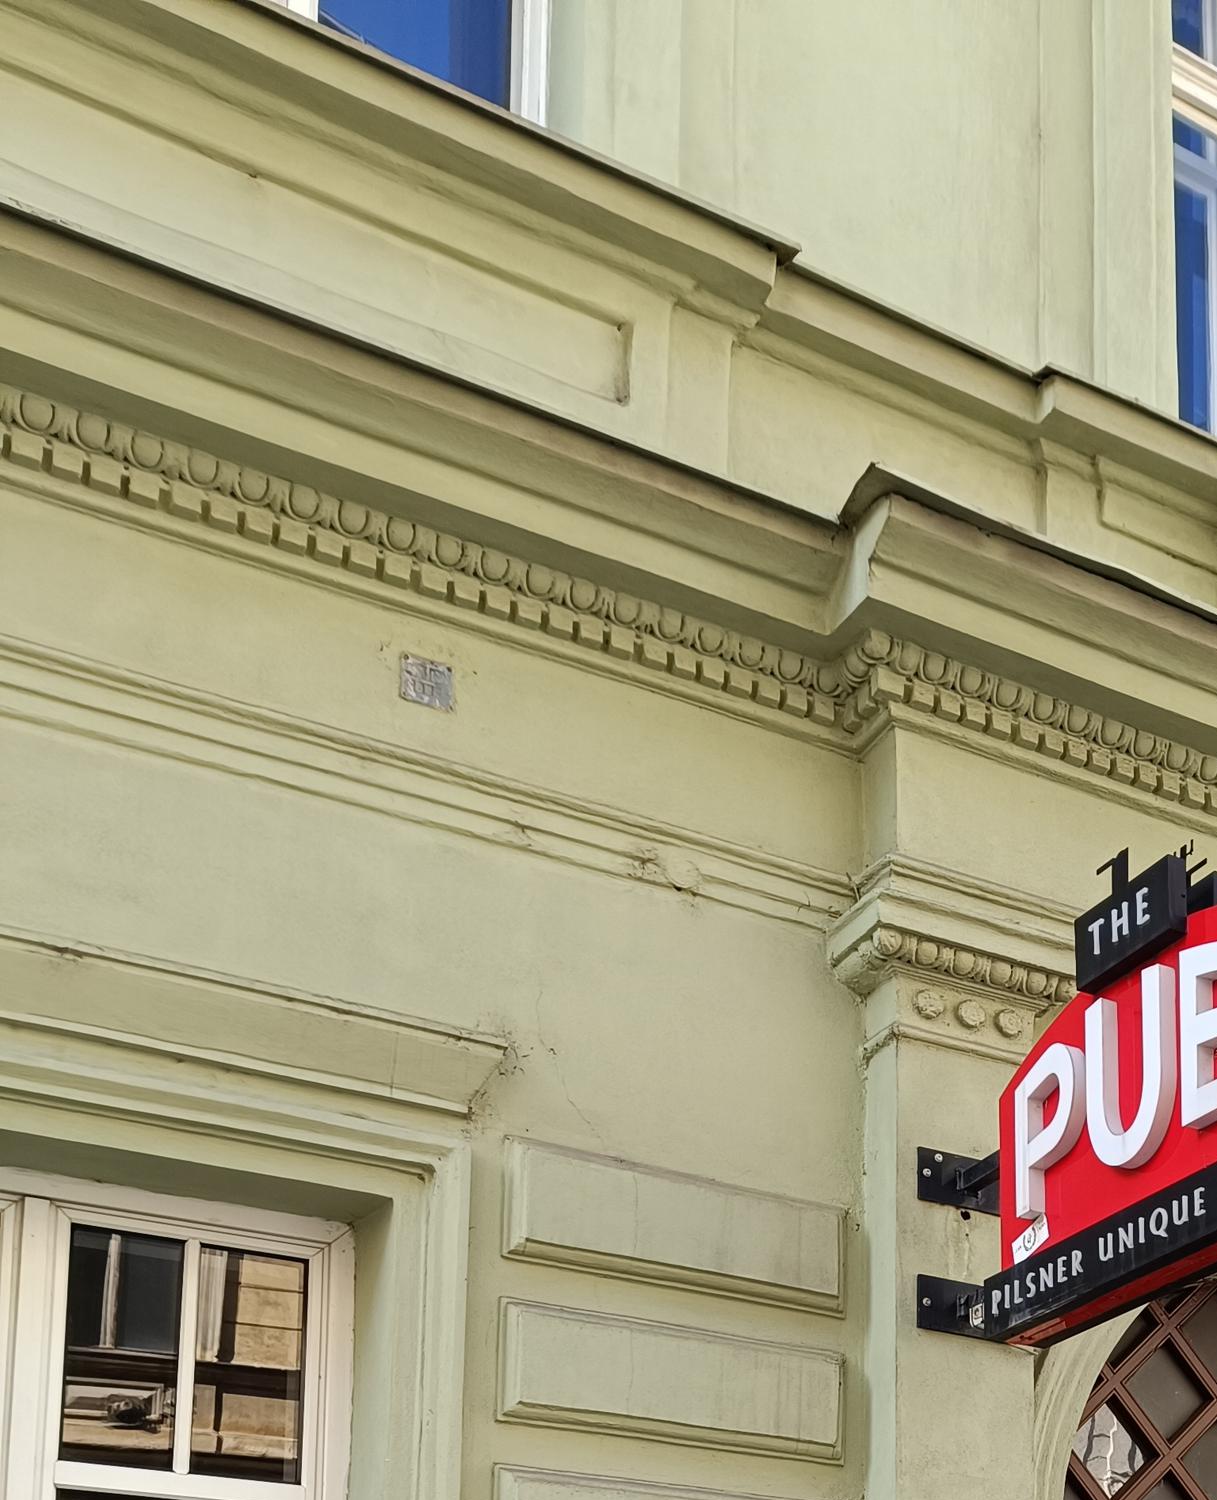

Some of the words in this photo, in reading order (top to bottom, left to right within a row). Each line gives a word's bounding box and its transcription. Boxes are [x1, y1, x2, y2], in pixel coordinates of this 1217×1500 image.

[1088, 887, 1150, 955] THE
[991, 1250, 1084, 1315] PILSNER
[1098, 1187, 1206, 1262] UNIQUE
